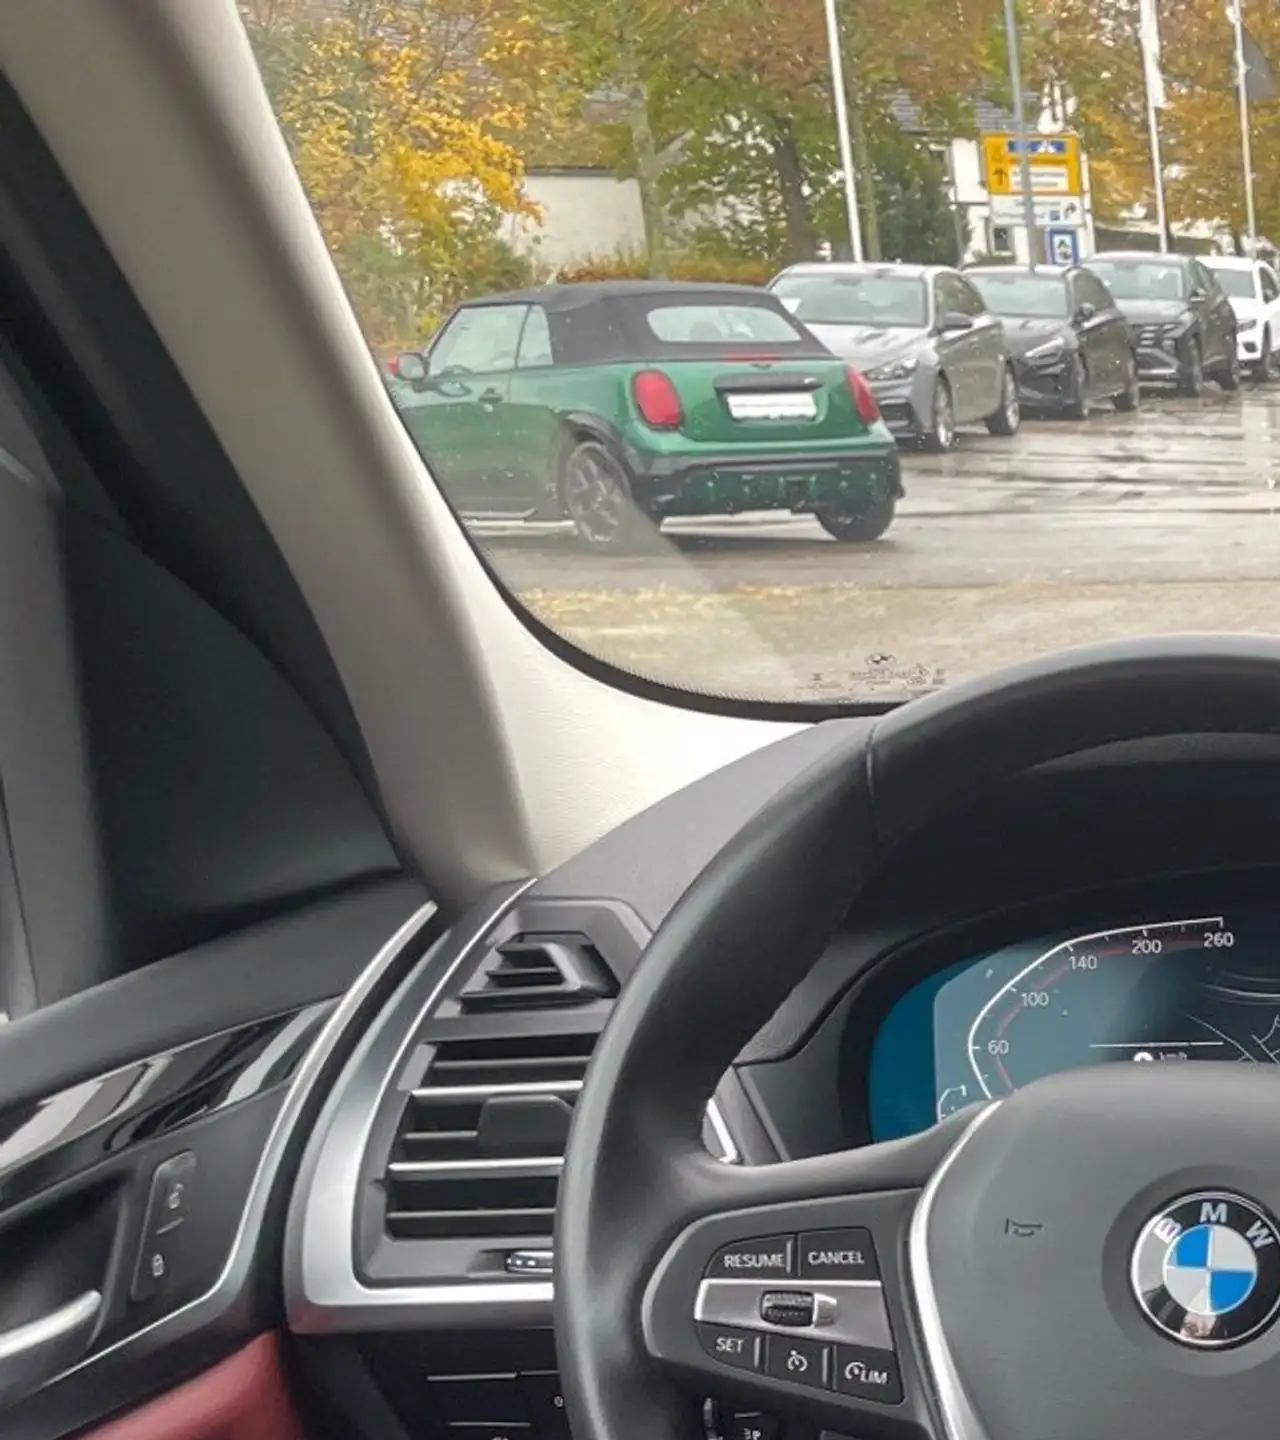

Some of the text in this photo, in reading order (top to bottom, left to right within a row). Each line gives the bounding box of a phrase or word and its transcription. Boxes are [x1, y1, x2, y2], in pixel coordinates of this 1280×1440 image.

[1131, 938, 1162, 954] 200
[1203, 931, 1234, 948] 260
[1069, 955, 1098, 971] 140
[1020, 992, 1050, 1008] 100
[987, 1039, 1010, 1056] 60
[1152, 1202, 1276, 1250] BMW
[723, 1254, 785, 1268] RESUME
[807, 1251, 865, 1265] CANCEL
[715, 1337, 745, 1352] SET
